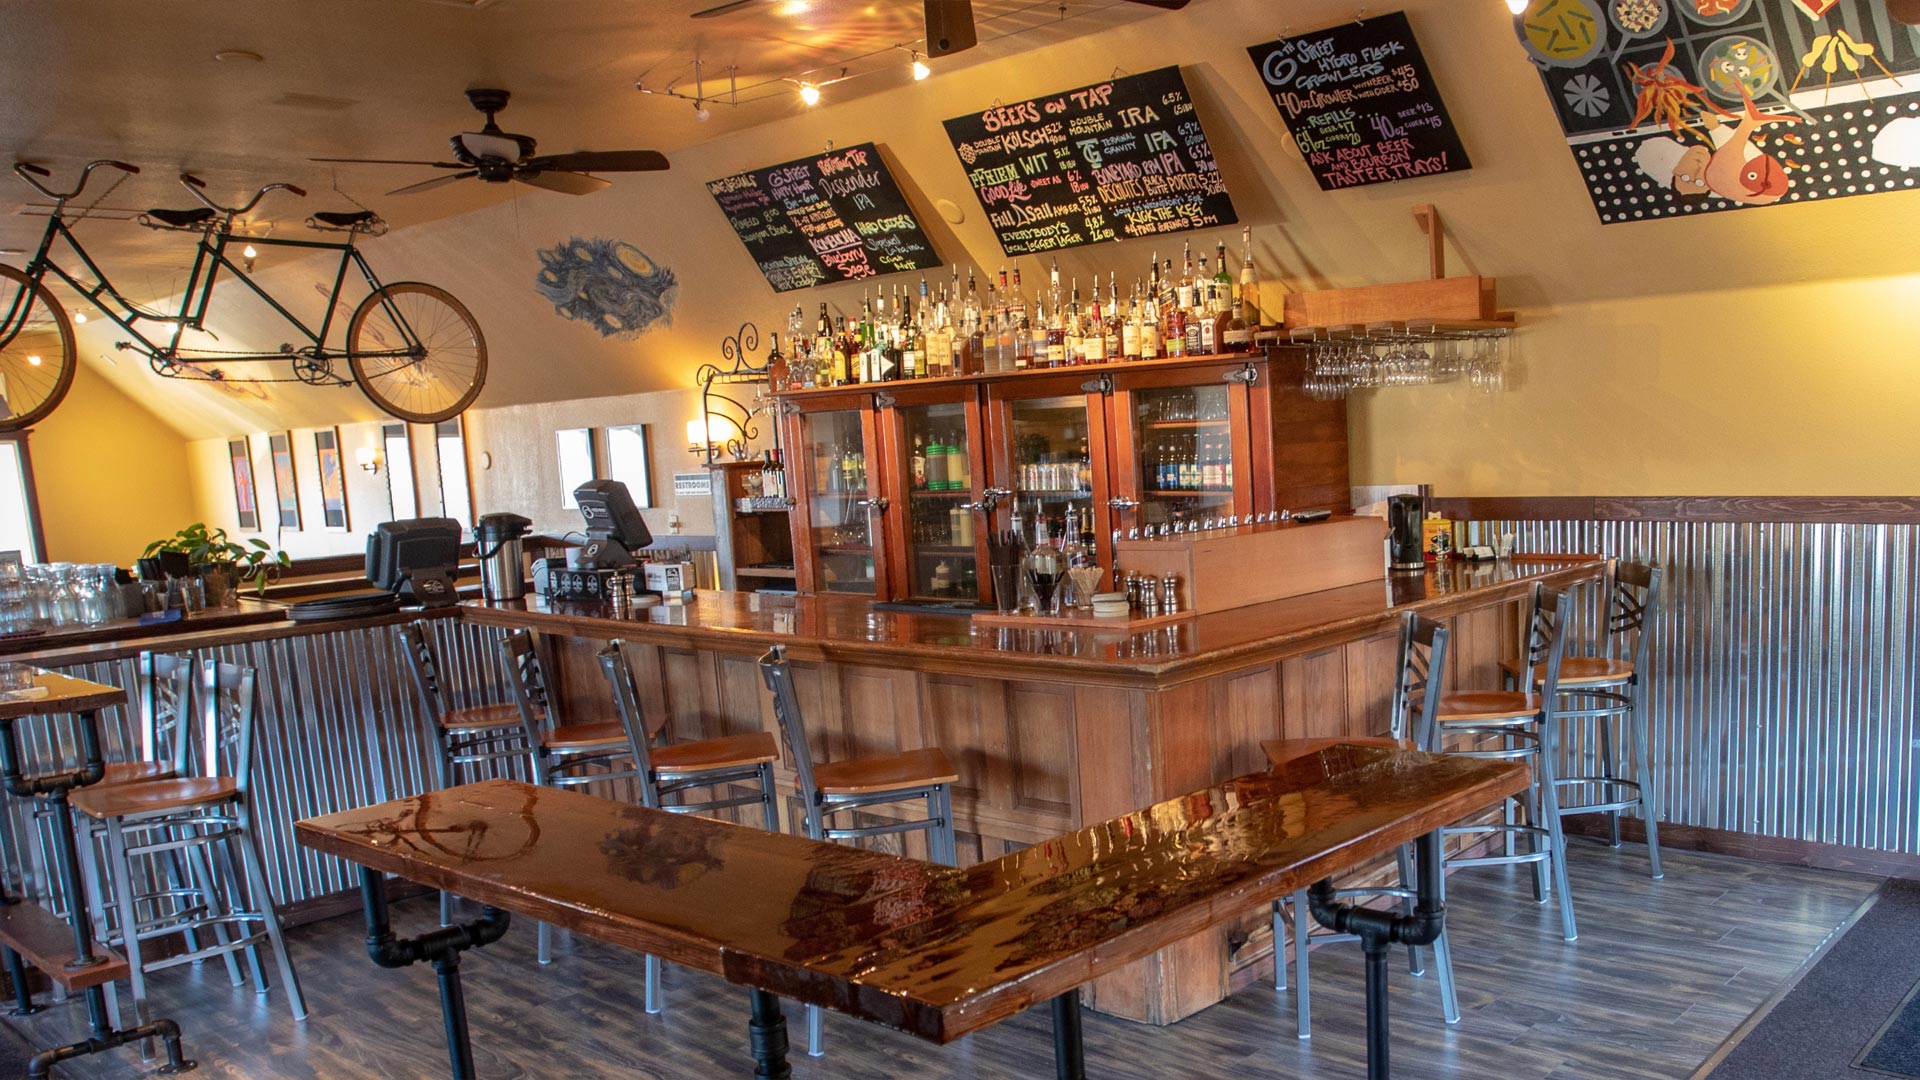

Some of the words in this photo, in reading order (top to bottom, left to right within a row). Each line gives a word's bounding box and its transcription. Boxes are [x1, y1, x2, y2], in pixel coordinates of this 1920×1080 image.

[1297, 38, 1334, 63] STREET
[1317, 53, 1358, 72] HYDRO
[1361, 41, 1404, 62] FLASK
[1296, 61, 1385, 90] GROWLERS
[1372, 75, 1394, 86] BEER
[1391, 64, 1415, 80] $45
[1374, 84, 1400, 96] CIDER
[1397, 77, 1419, 92] $50
[982, 101, 1040, 131] BEERS
[1044, 98, 1067, 114] ON
[1070, 84, 1112, 110] TAP
[1162, 91, 1182, 105] 6.5%
[1309, 88, 1358, 109] GROWLER
[1117, 105, 1160, 129] IRA
[1416, 102, 1434, 114] $13
[1068, 120, 1113, 136] MOUNTAIN
[1069, 113, 1104, 127] DOUBLE
[1178, 121, 1200, 135] 6.9%
[1337, 121, 1355, 133] $17
[1425, 115, 1442, 128] $15
[973, 136, 1001, 149] DOUBLE
[1101, 132, 1136, 147] TERMINAL
[1104, 141, 1137, 155] GRAVITY
[1144, 130, 1178, 153] IPA
[846, 148, 868, 166] TAP
[1310, 152, 1334, 166] ASK
[1336, 145, 1372, 162] ABOUT
[1377, 138, 1415, 155] BEER
[1331, 163, 1349, 172] AND
[1351, 150, 1411, 170] BOURBON
[1018, 152, 1048, 175] WIT
[1091, 161, 1142, 185] BONEYARD
[1159, 150, 1186, 177] IPA
[1322, 167, 1392, 188] TASTER
[1391, 152, 1449, 177] TRAYS!
[783, 165, 810, 183] STREET
[1052, 175, 1062, 184] AS
[1066, 170, 1082, 182] 6%
[1166, 173, 1204, 193] PORTER
[771, 183, 795, 200] HAPPY
[793, 180, 814, 195] HOUR
[1097, 178, 1145, 204] DESCHUTES
[852, 193, 875, 211] IPA
[1053, 204, 1081, 217] AMBER
[1113, 207, 1131, 217] JOIN
[1153, 206, 1176, 220] THE
[854, 221, 879, 236] HARD
[877, 214, 917, 232] CIDERS
[1001, 221, 1070, 241] EVERYBODY'S
[809, 228, 861, 253] KOMBUCHA
[1025, 238, 1056, 252] LOGGER
[1054, 233, 1083, 247] LAGER
[821, 248, 868, 267] Blueberry
[838, 263, 876, 278] Sage
[675, 481, 710, 489] RESTROOMS
